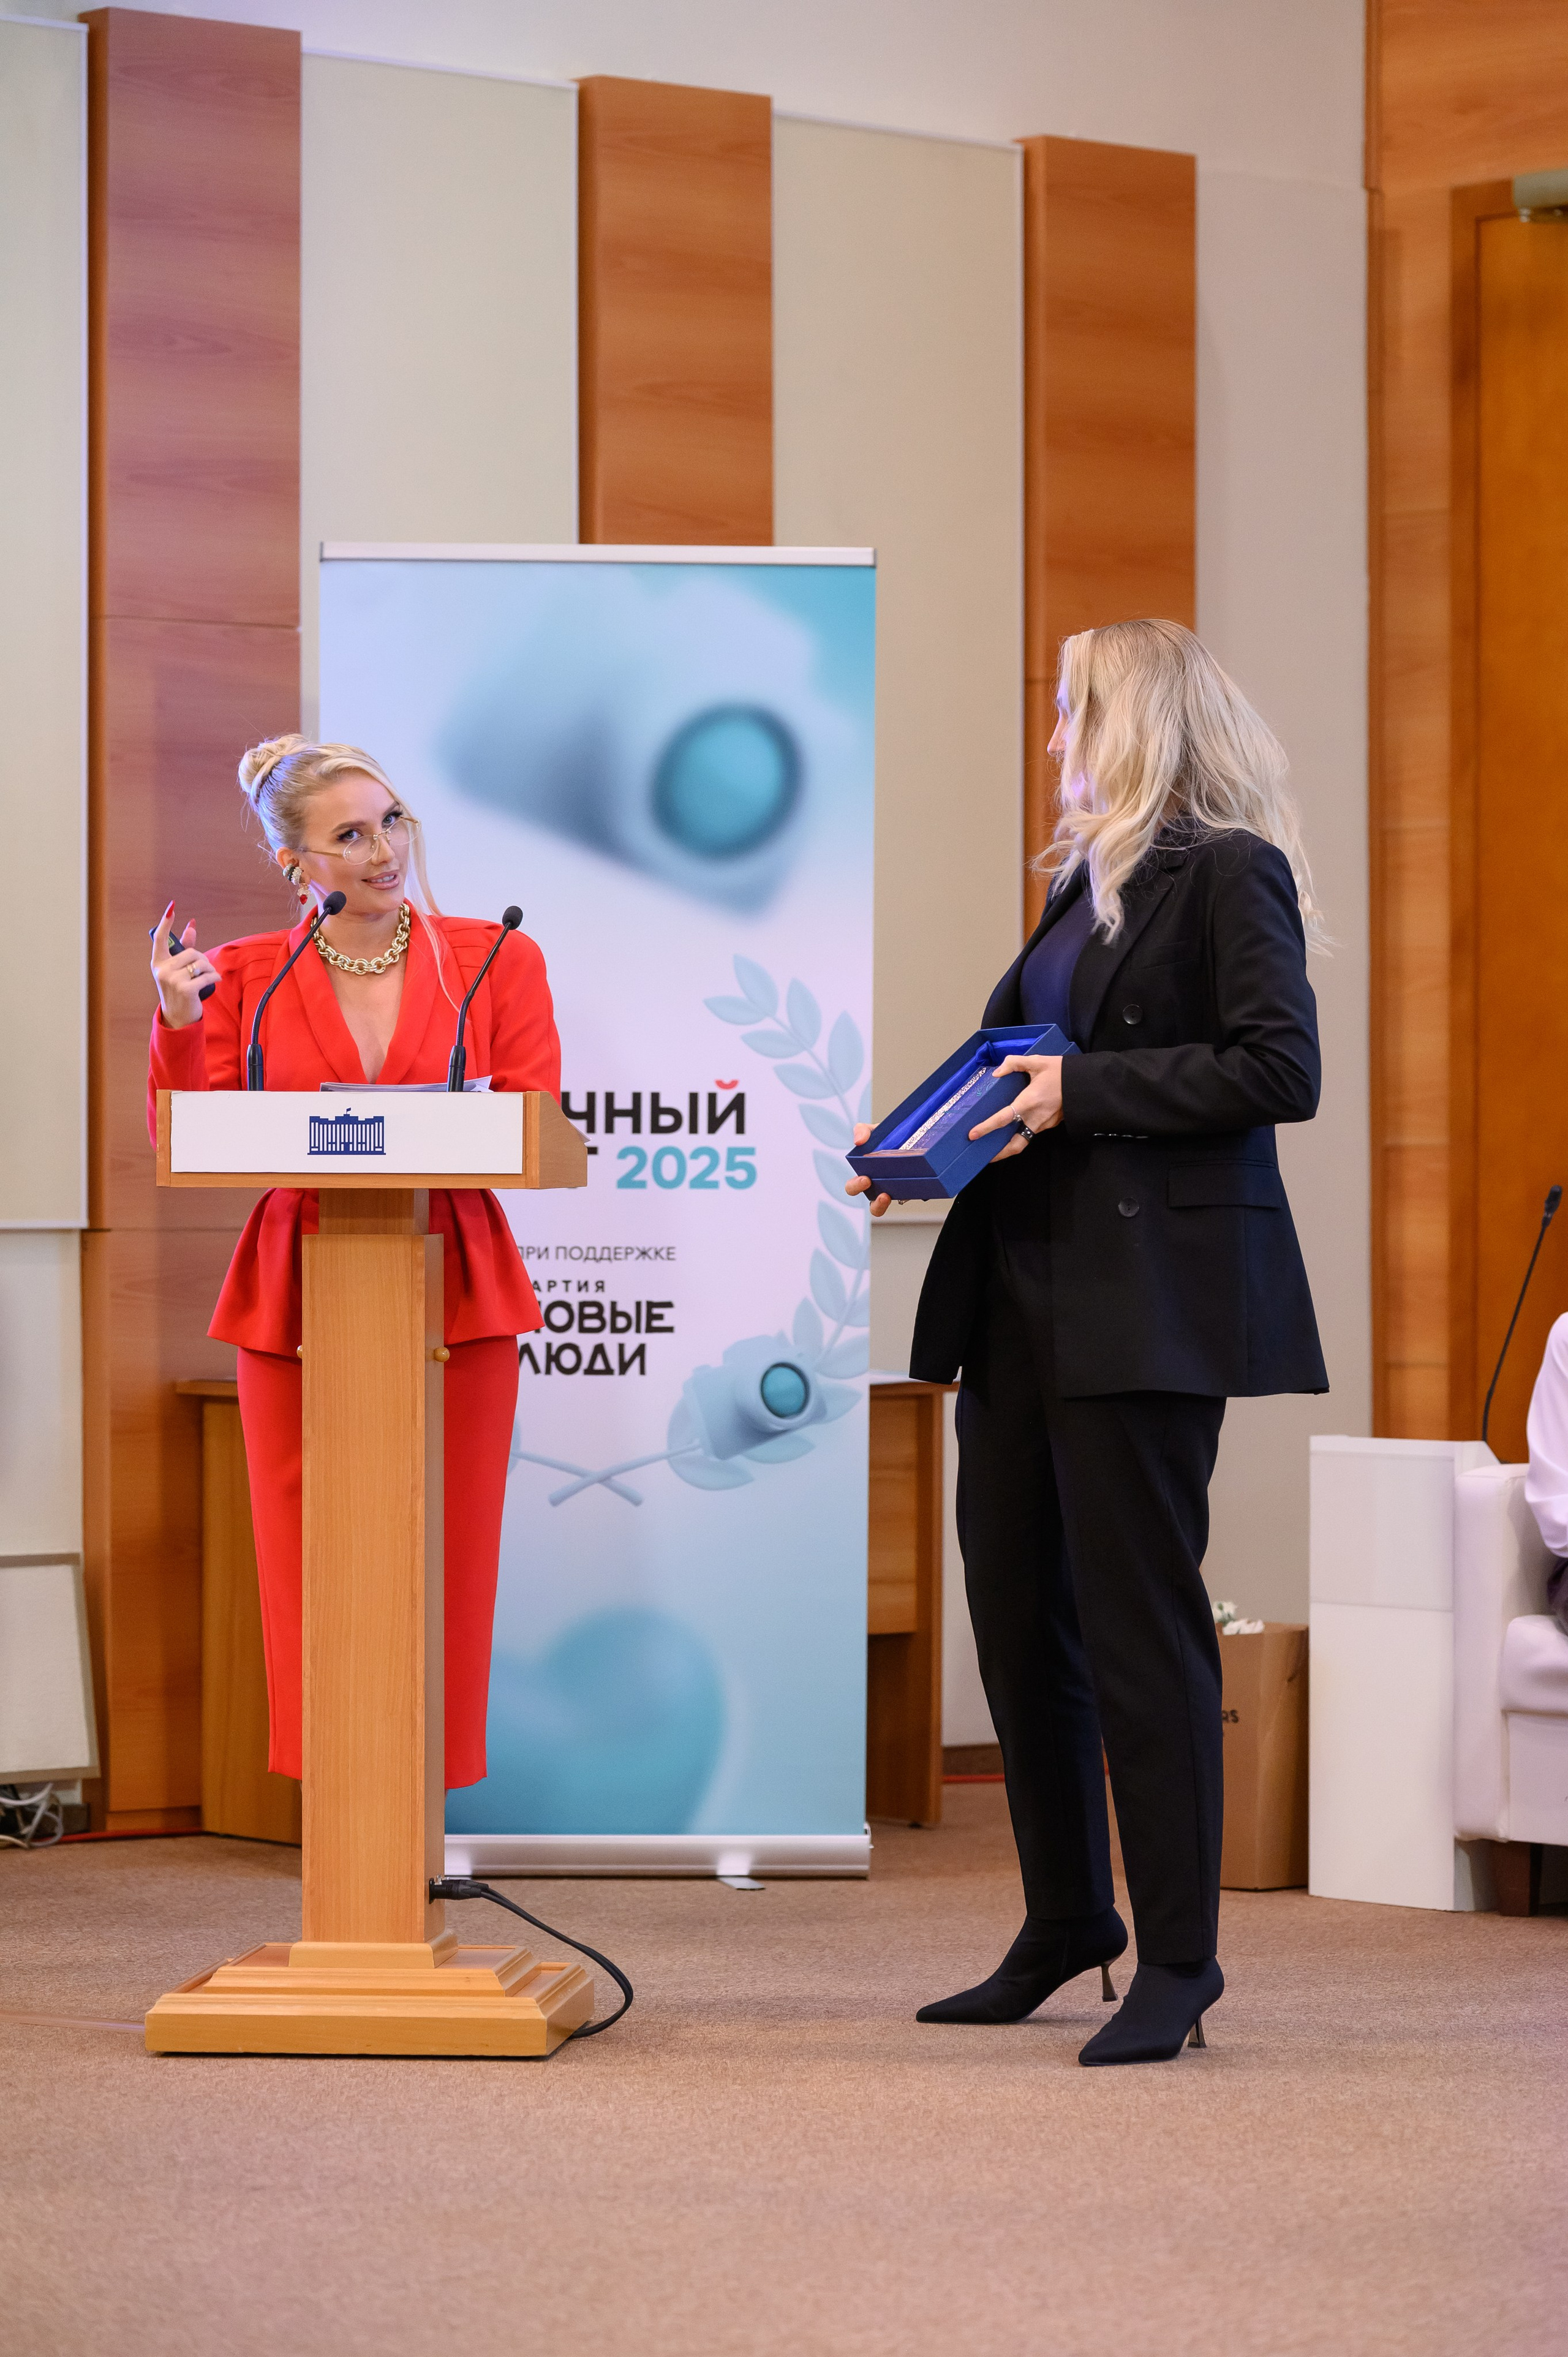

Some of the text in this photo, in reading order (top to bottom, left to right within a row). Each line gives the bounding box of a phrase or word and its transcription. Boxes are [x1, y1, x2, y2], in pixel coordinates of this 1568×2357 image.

[616, 1146, 757, 1190] 2025
[555, 1246, 676, 1263] ПОДДЕРЖКЕ
[519, 1343, 646, 1376] ЛЮДИ
